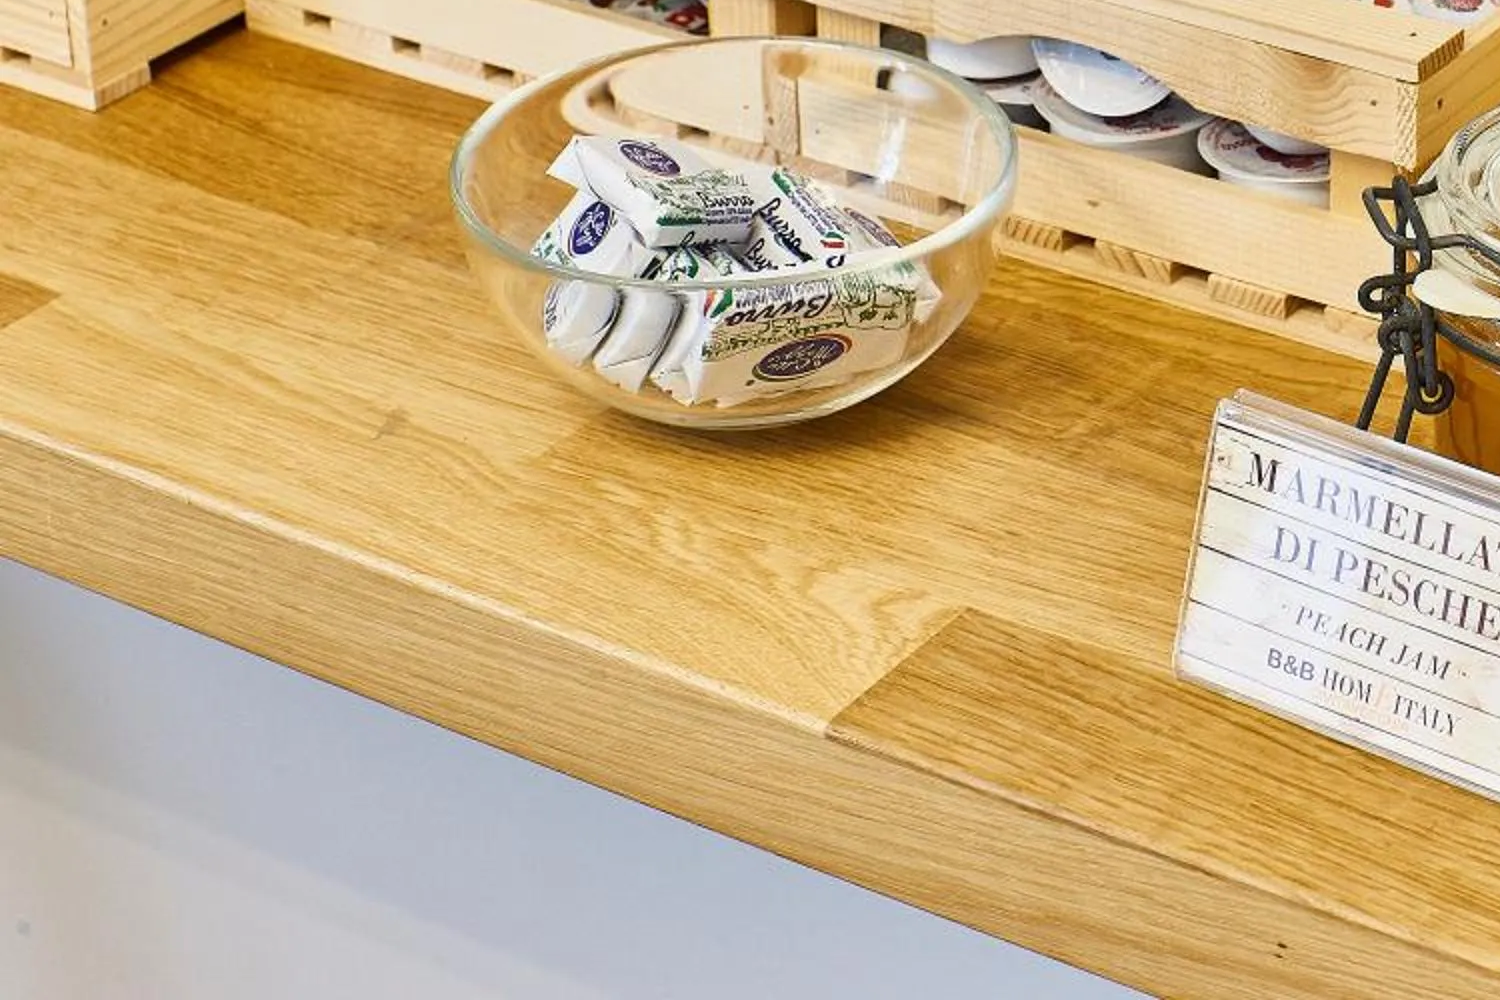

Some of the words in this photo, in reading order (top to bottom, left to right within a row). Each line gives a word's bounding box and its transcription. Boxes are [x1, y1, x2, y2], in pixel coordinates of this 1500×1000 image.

[723, 291, 833, 327] Burro
[1270, 525, 1318, 572] DI
[1295, 605, 1390, 657] PEACH
[1389, 643, 1452, 681] JAM
[1266, 647, 1316, 682] B&B
[1392, 693, 1464, 737] ITALY
